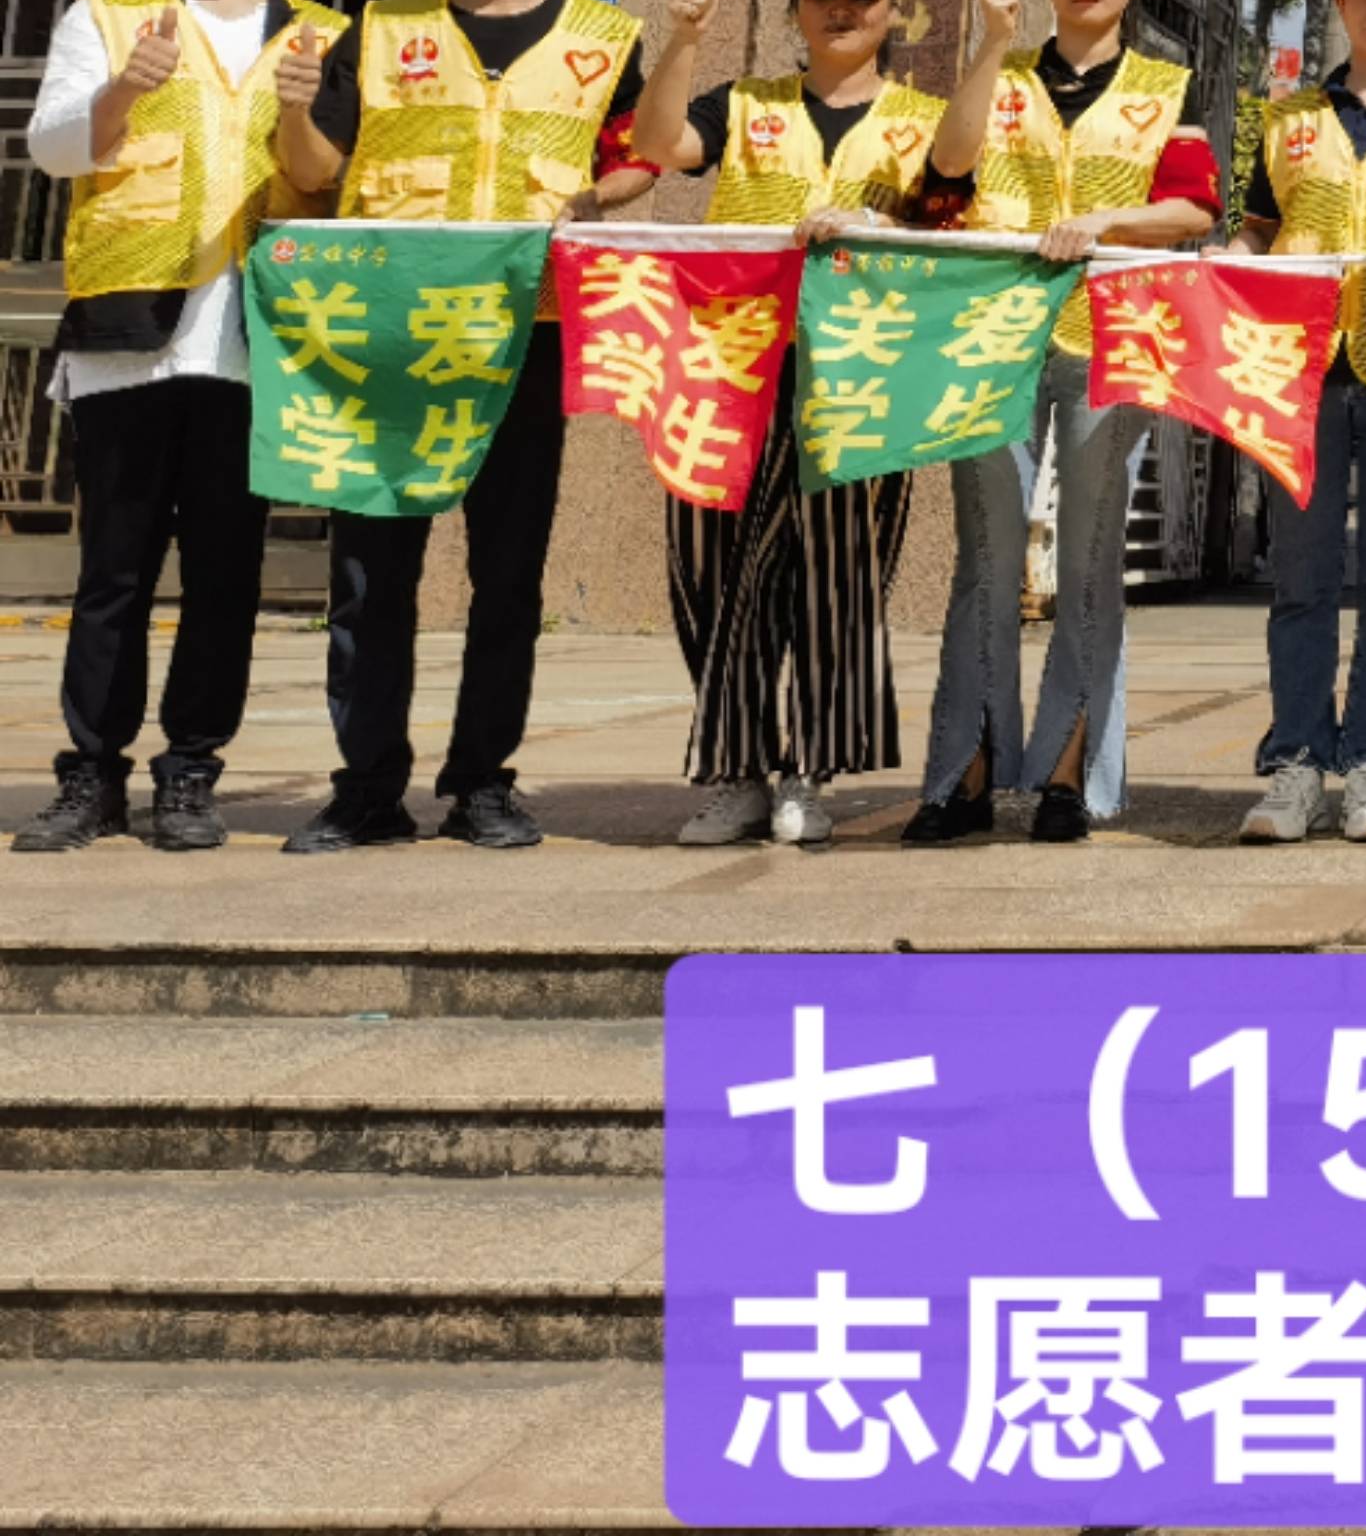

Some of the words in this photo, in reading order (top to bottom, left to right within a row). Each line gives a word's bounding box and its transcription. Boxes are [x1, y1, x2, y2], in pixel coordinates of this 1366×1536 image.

[272, 279, 515, 385] 关爱
[579, 253, 781, 394] 关爱
[810, 285, 1049, 366] 关爱
[280, 392, 490, 497] 学生
[581, 330, 741, 501] 学生
[801, 376, 1015, 475] 学生
